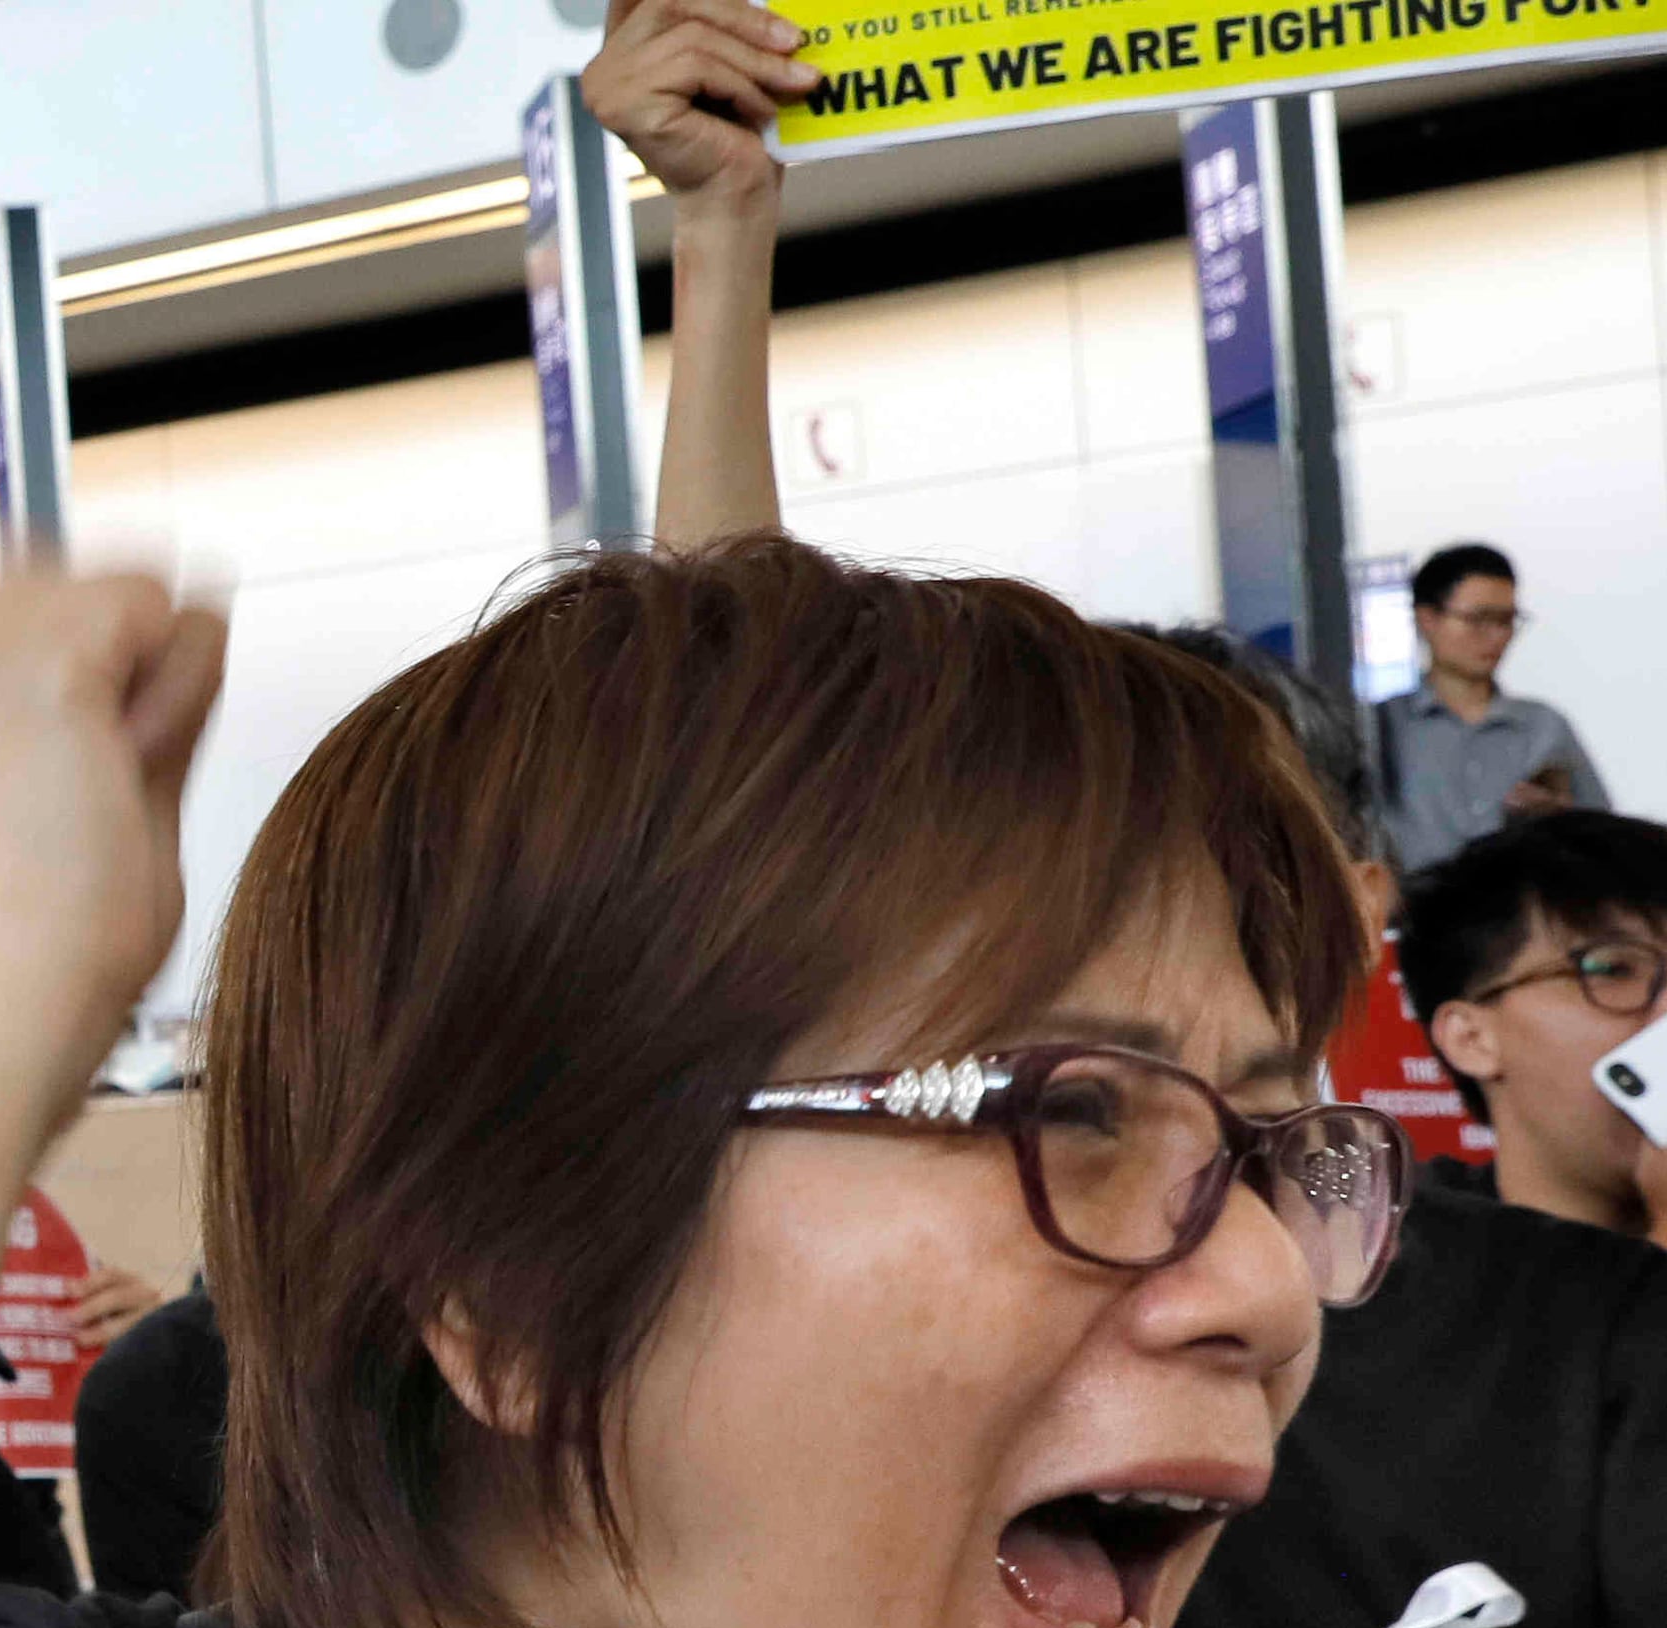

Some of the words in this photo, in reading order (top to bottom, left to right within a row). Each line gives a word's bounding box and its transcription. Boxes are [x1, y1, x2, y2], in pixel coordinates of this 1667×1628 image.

[808, 56, 965, 115] WHAT
[978, 42, 1066, 92] WE
[1084, 23, 1200, 80] ARE
[1214, 0, 1486, 62] FIGHTING
[843, 17, 899, 40] YOU
[912, 7, 992, 32] STILL
